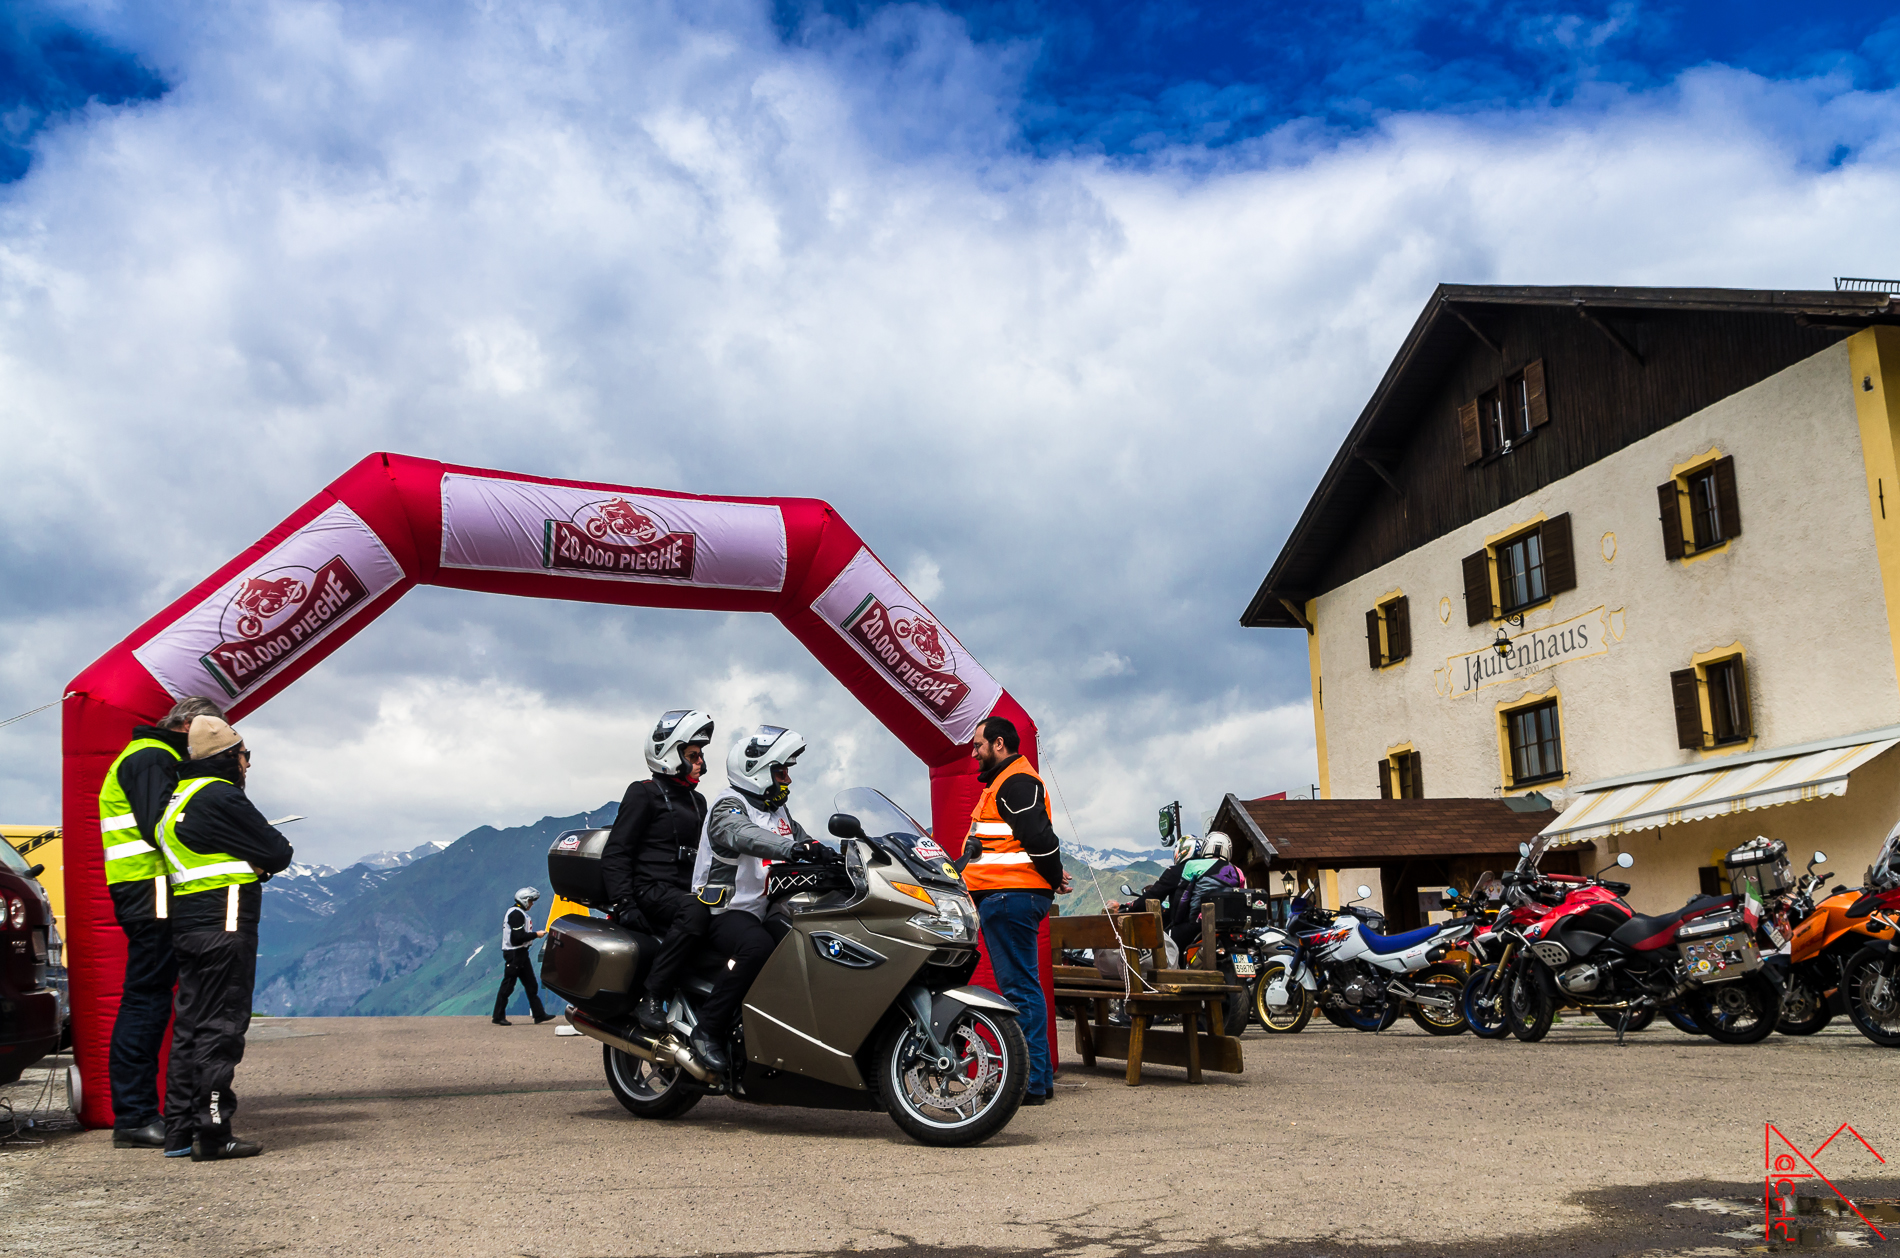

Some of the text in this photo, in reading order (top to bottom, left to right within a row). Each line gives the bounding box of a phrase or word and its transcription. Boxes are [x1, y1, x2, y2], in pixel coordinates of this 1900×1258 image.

[559, 527, 683, 570] 20.000 PIEGHE
[220, 570, 351, 677] 20.000 PIEGHE
[860, 608, 958, 706] 20.000 PIEGHE
